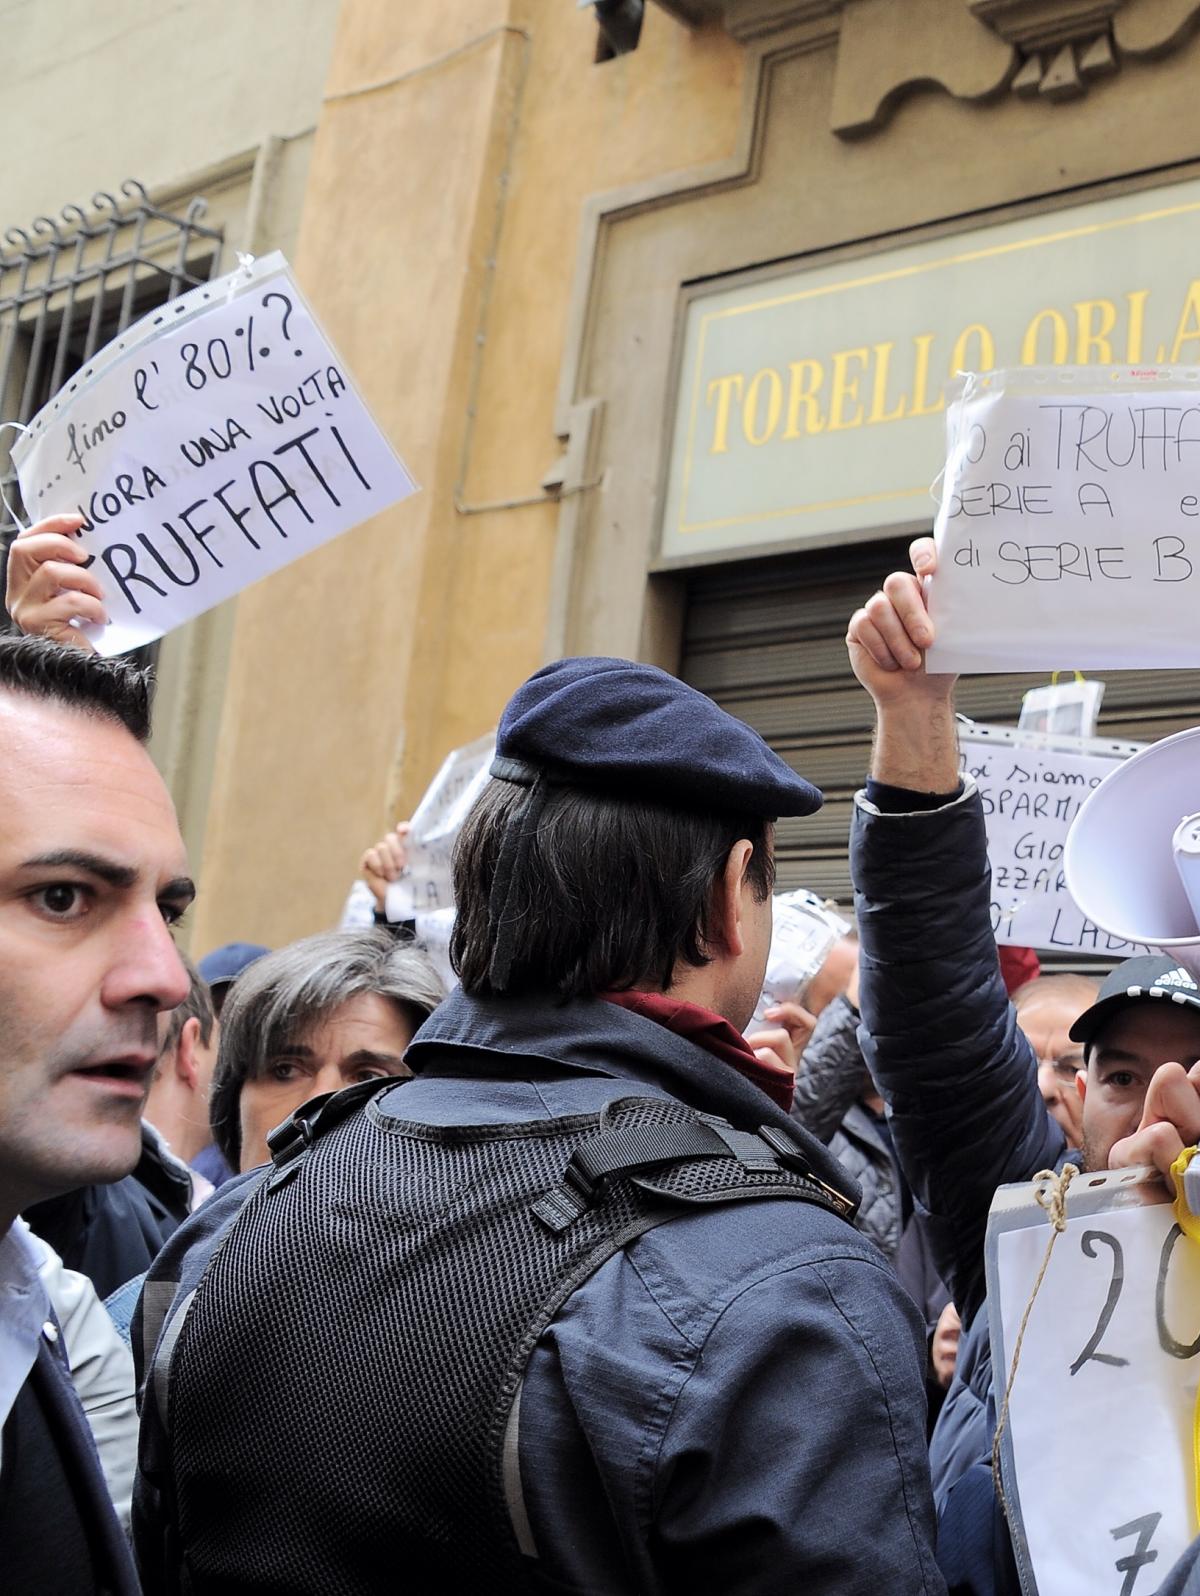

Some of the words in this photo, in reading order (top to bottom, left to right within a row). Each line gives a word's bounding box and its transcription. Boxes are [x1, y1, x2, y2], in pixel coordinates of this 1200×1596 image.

[706, 323, 996, 455] TORELLO
[74, 465, 168, 538] NCORA
[180, 418, 252, 468] UNA
[256, 365, 347, 426] VOLTA
[1004, 428, 1031, 471] ai
[84, 413, 372, 614] RUFFATI
[1078, 482, 1115, 518] A
[1180, 495, 1200, 517] e
[953, 539, 981, 568] di
[992, 541, 1132, 585] SERIE
[1014, 831, 1065, 861] GIO
[1154, 977, 1198, 991] adidas
